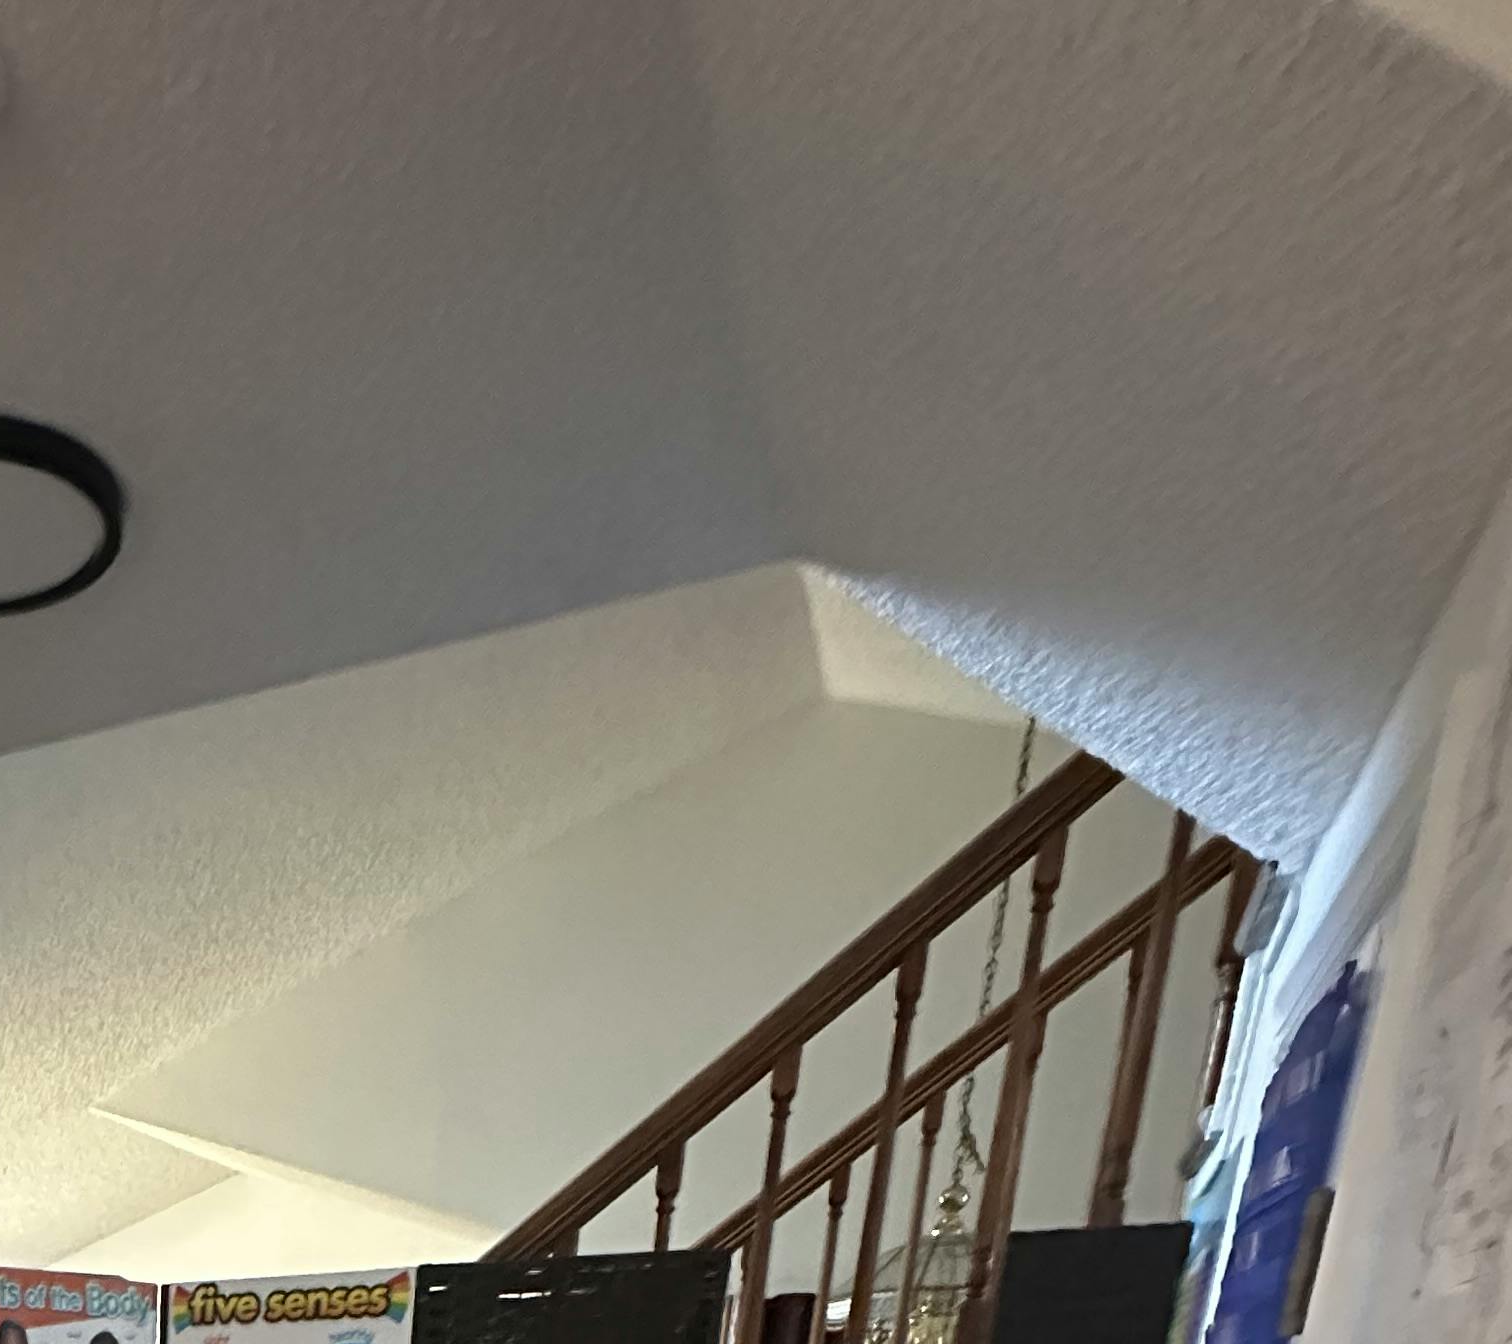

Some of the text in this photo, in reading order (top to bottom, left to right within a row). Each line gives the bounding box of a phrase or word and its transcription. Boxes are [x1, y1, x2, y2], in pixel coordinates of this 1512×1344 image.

[24, 1281, 47, 1309] of
[50, 1284, 84, 1312] the
[86, 1280, 149, 1327] Body
[189, 1282, 390, 1325] five senses
